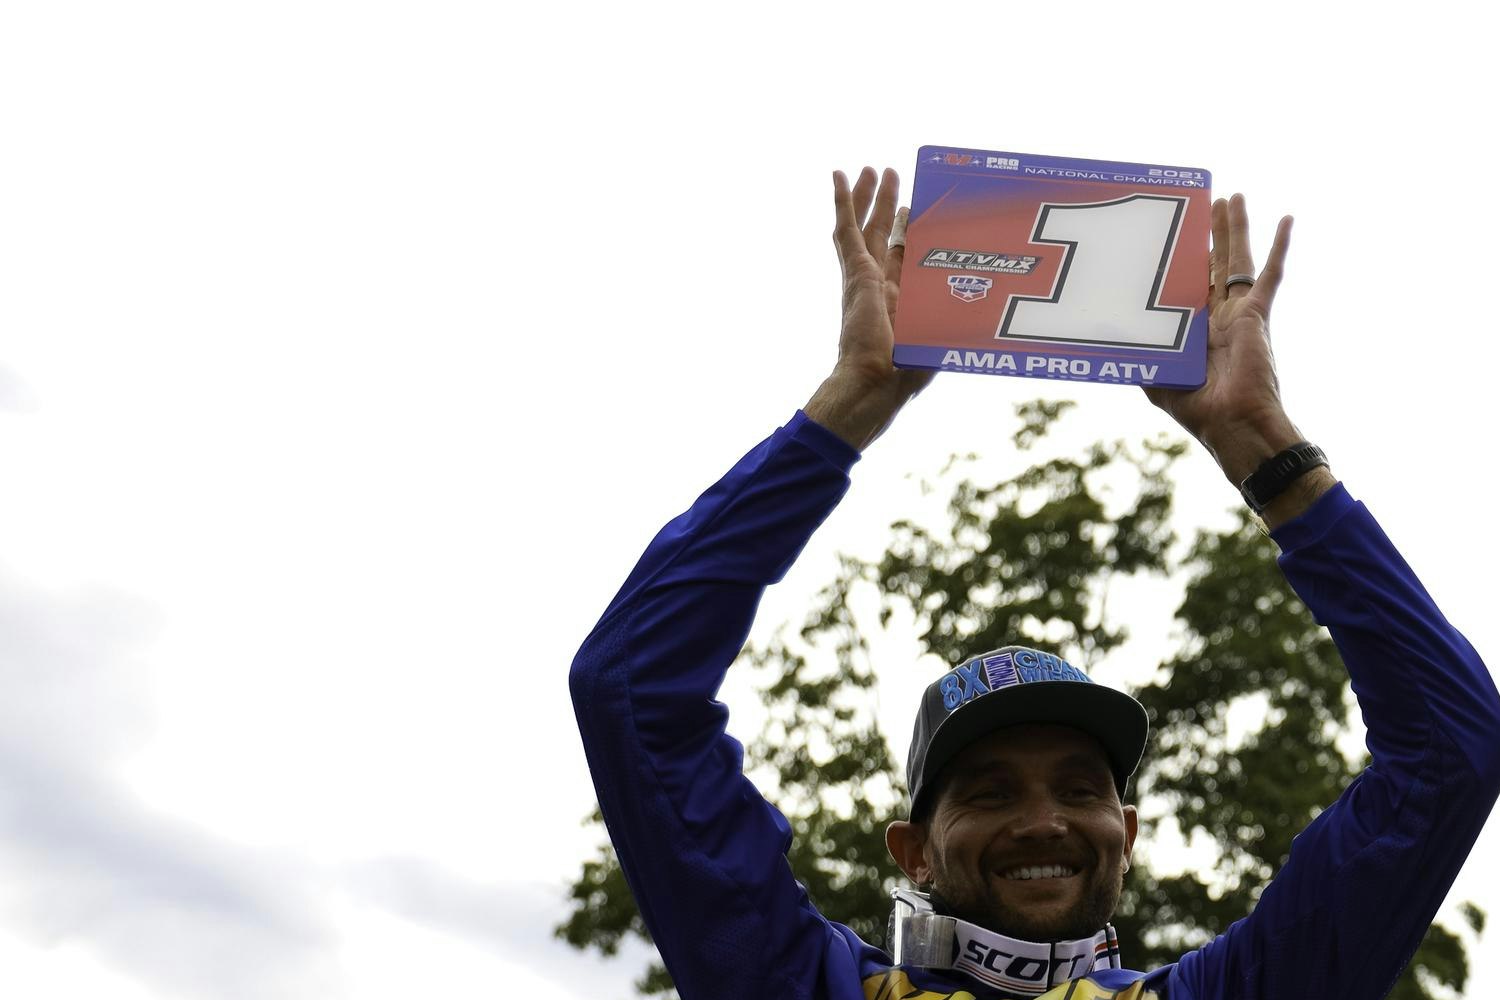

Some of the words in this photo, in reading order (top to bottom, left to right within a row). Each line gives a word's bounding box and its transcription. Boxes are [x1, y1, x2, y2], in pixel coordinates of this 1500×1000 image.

[986, 156, 1019, 167] PRO
[1148, 168, 1204, 181] 2021
[1024, 167, 1109, 181] NATIONAL
[1113, 175, 1205, 188] CHAMPION
[994, 193, 1195, 352] 1
[941, 350, 1017, 370] AMA
[1025, 356, 1091, 376] PRO
[1097, 362, 1159, 380] ATV
[940, 660, 990, 711] 8X
[966, 938, 1086, 982] SCOTT
